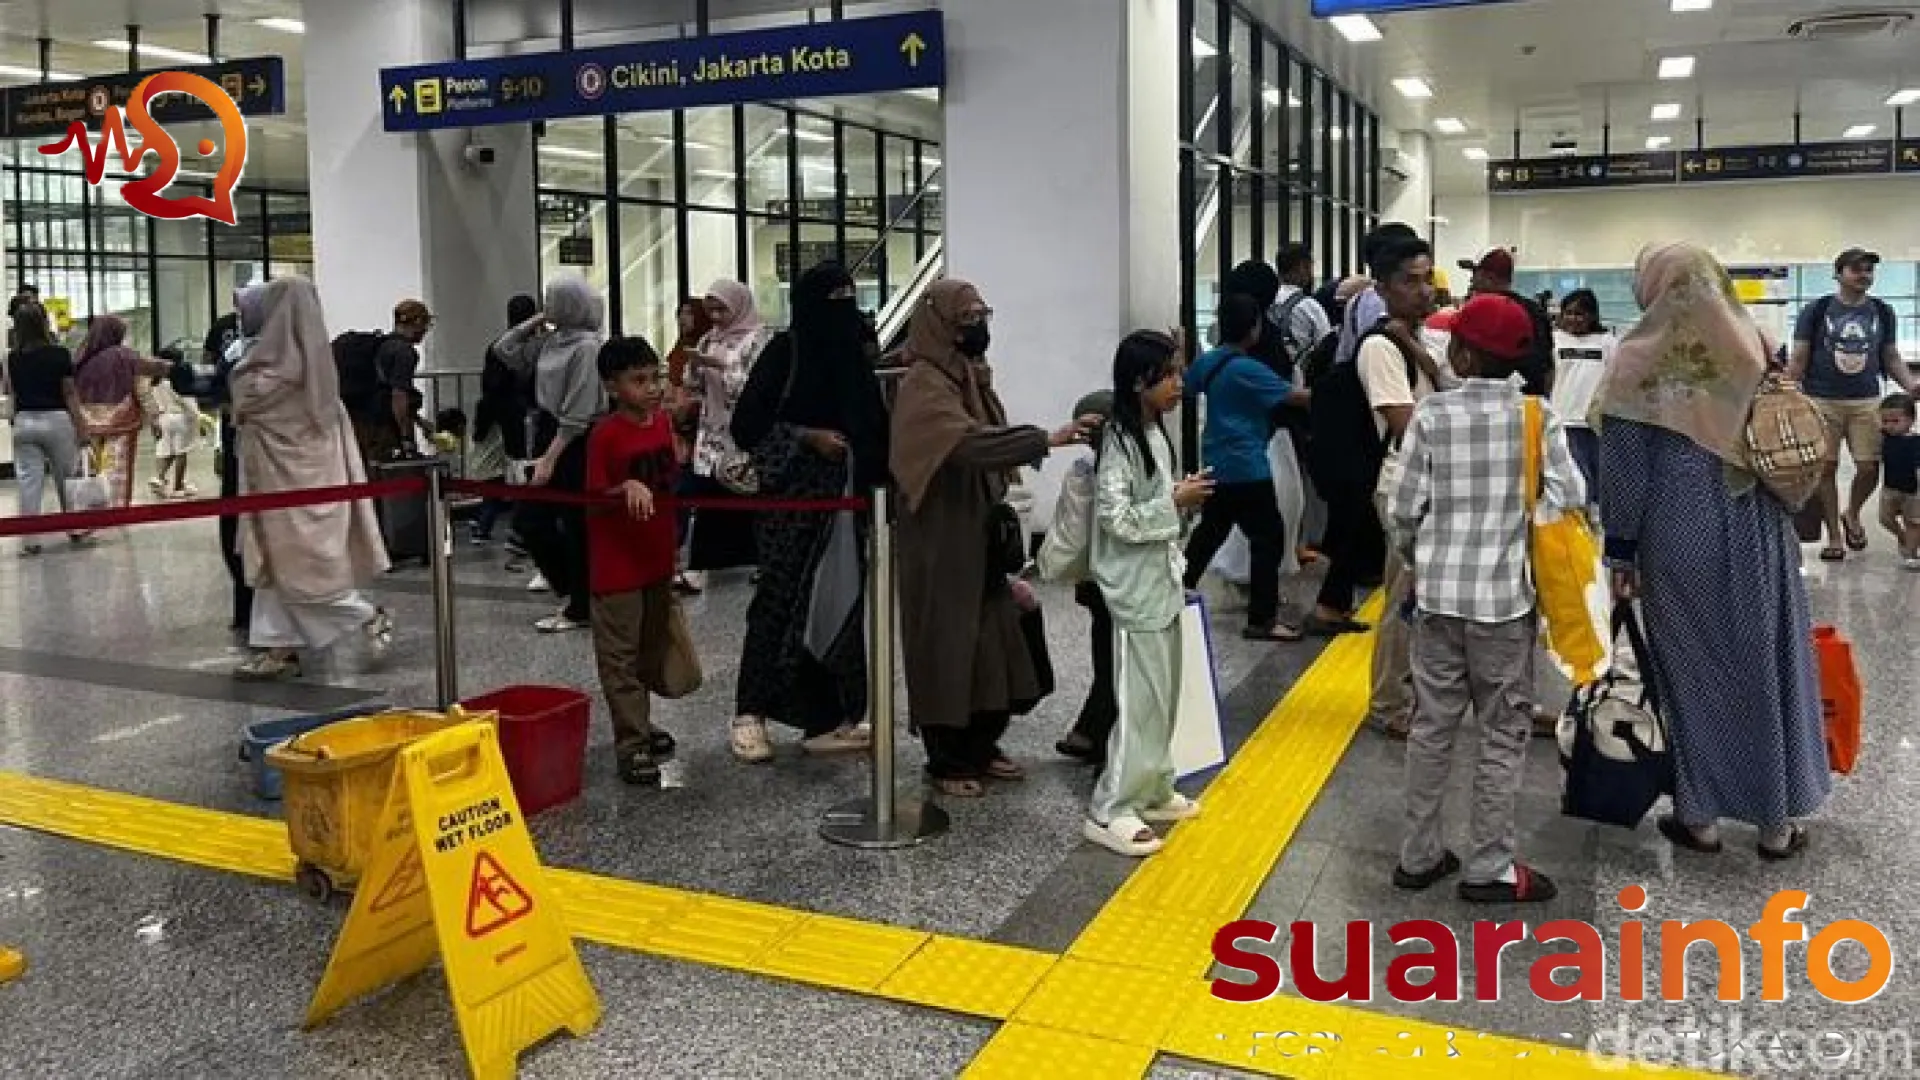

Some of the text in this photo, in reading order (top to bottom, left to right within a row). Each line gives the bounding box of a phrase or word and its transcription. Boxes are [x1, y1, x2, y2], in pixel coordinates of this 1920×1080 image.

[611, 60, 687, 88] Cikini,
[693, 53, 784, 82] Jakarta
[791, 45, 849, 73] Kota
[434, 811, 513, 853] WET FLOOR
[438, 797, 500, 831] CAUTION
